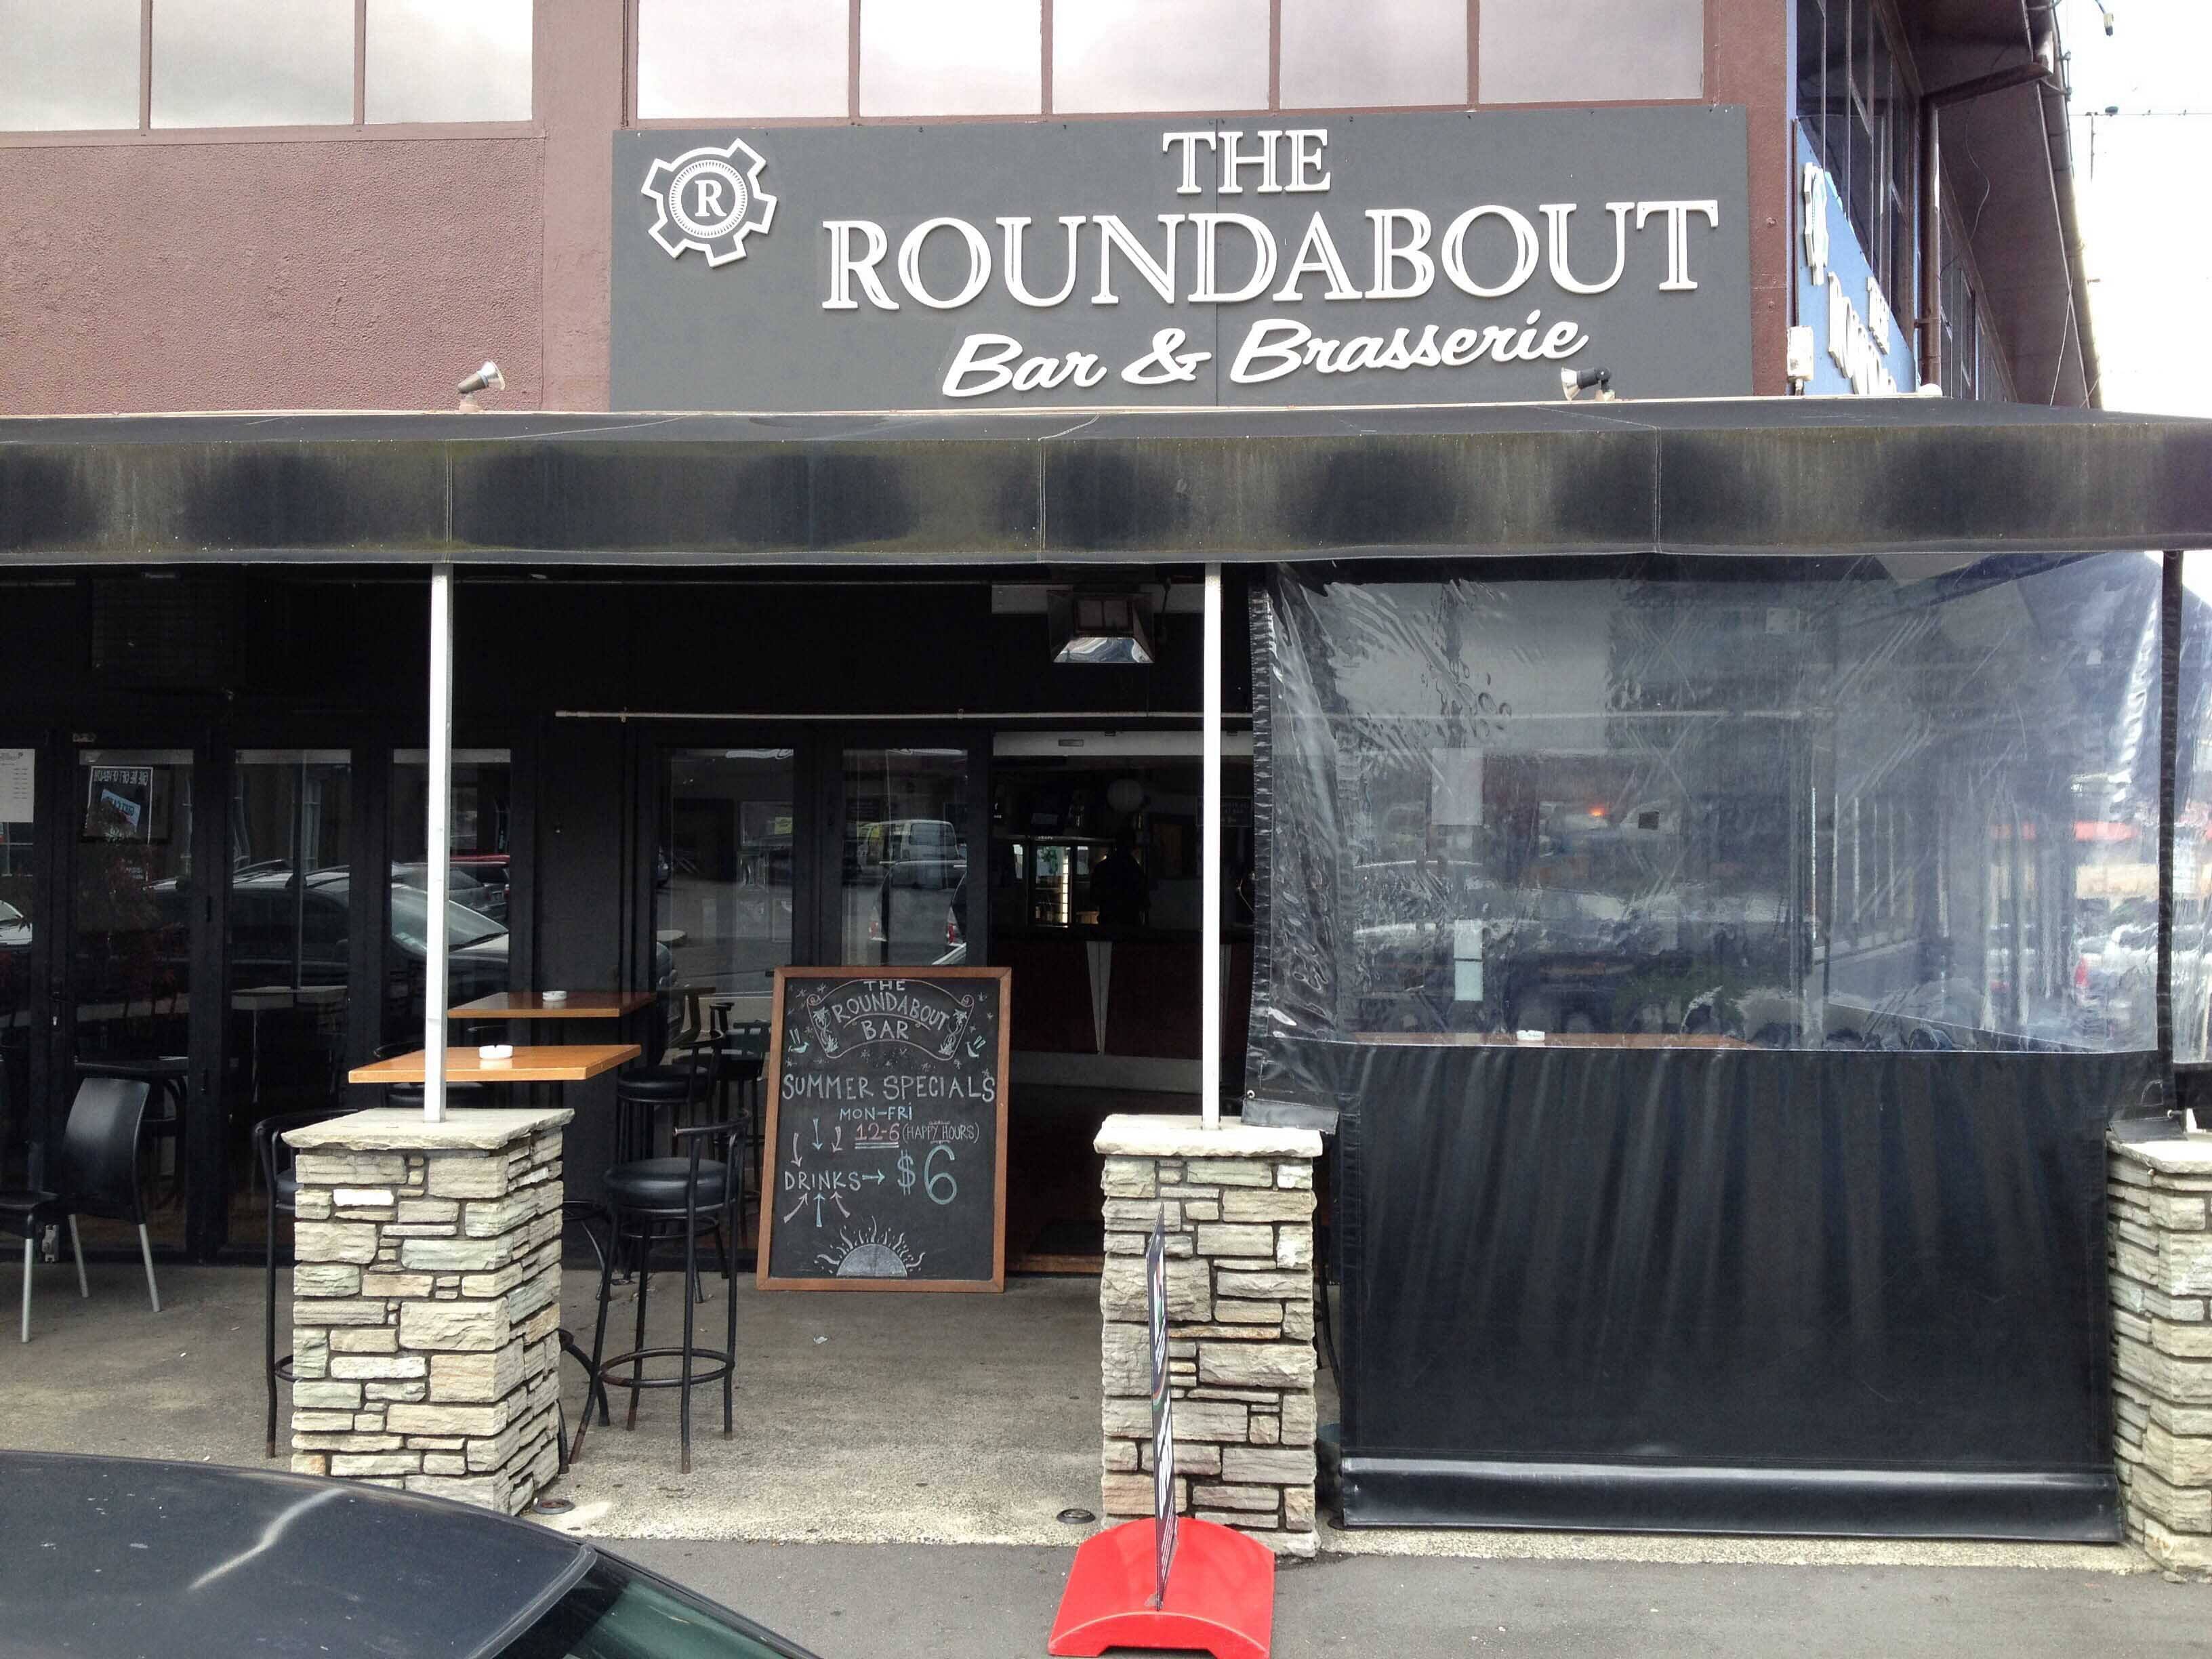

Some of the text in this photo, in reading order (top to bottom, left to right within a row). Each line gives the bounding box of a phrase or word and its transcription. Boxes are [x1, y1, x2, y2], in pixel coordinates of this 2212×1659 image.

[1162, 128, 1332, 194] THE
[695, 180, 727, 217] R
[821, 199, 1719, 310] ROUNDABOUT
[941, 309, 1589, 398] Bar & Brasserie
[863, 980, 906, 991] THE
[832, 991, 949, 1029] ROUNDABOUT
[861, 1020, 909, 1040] BAR
[782, 1073, 996, 1103] SUMMER SPECIALS
[855, 1123, 900, 1141] 12-6
[785, 1171, 861, 1192] DRINKS
